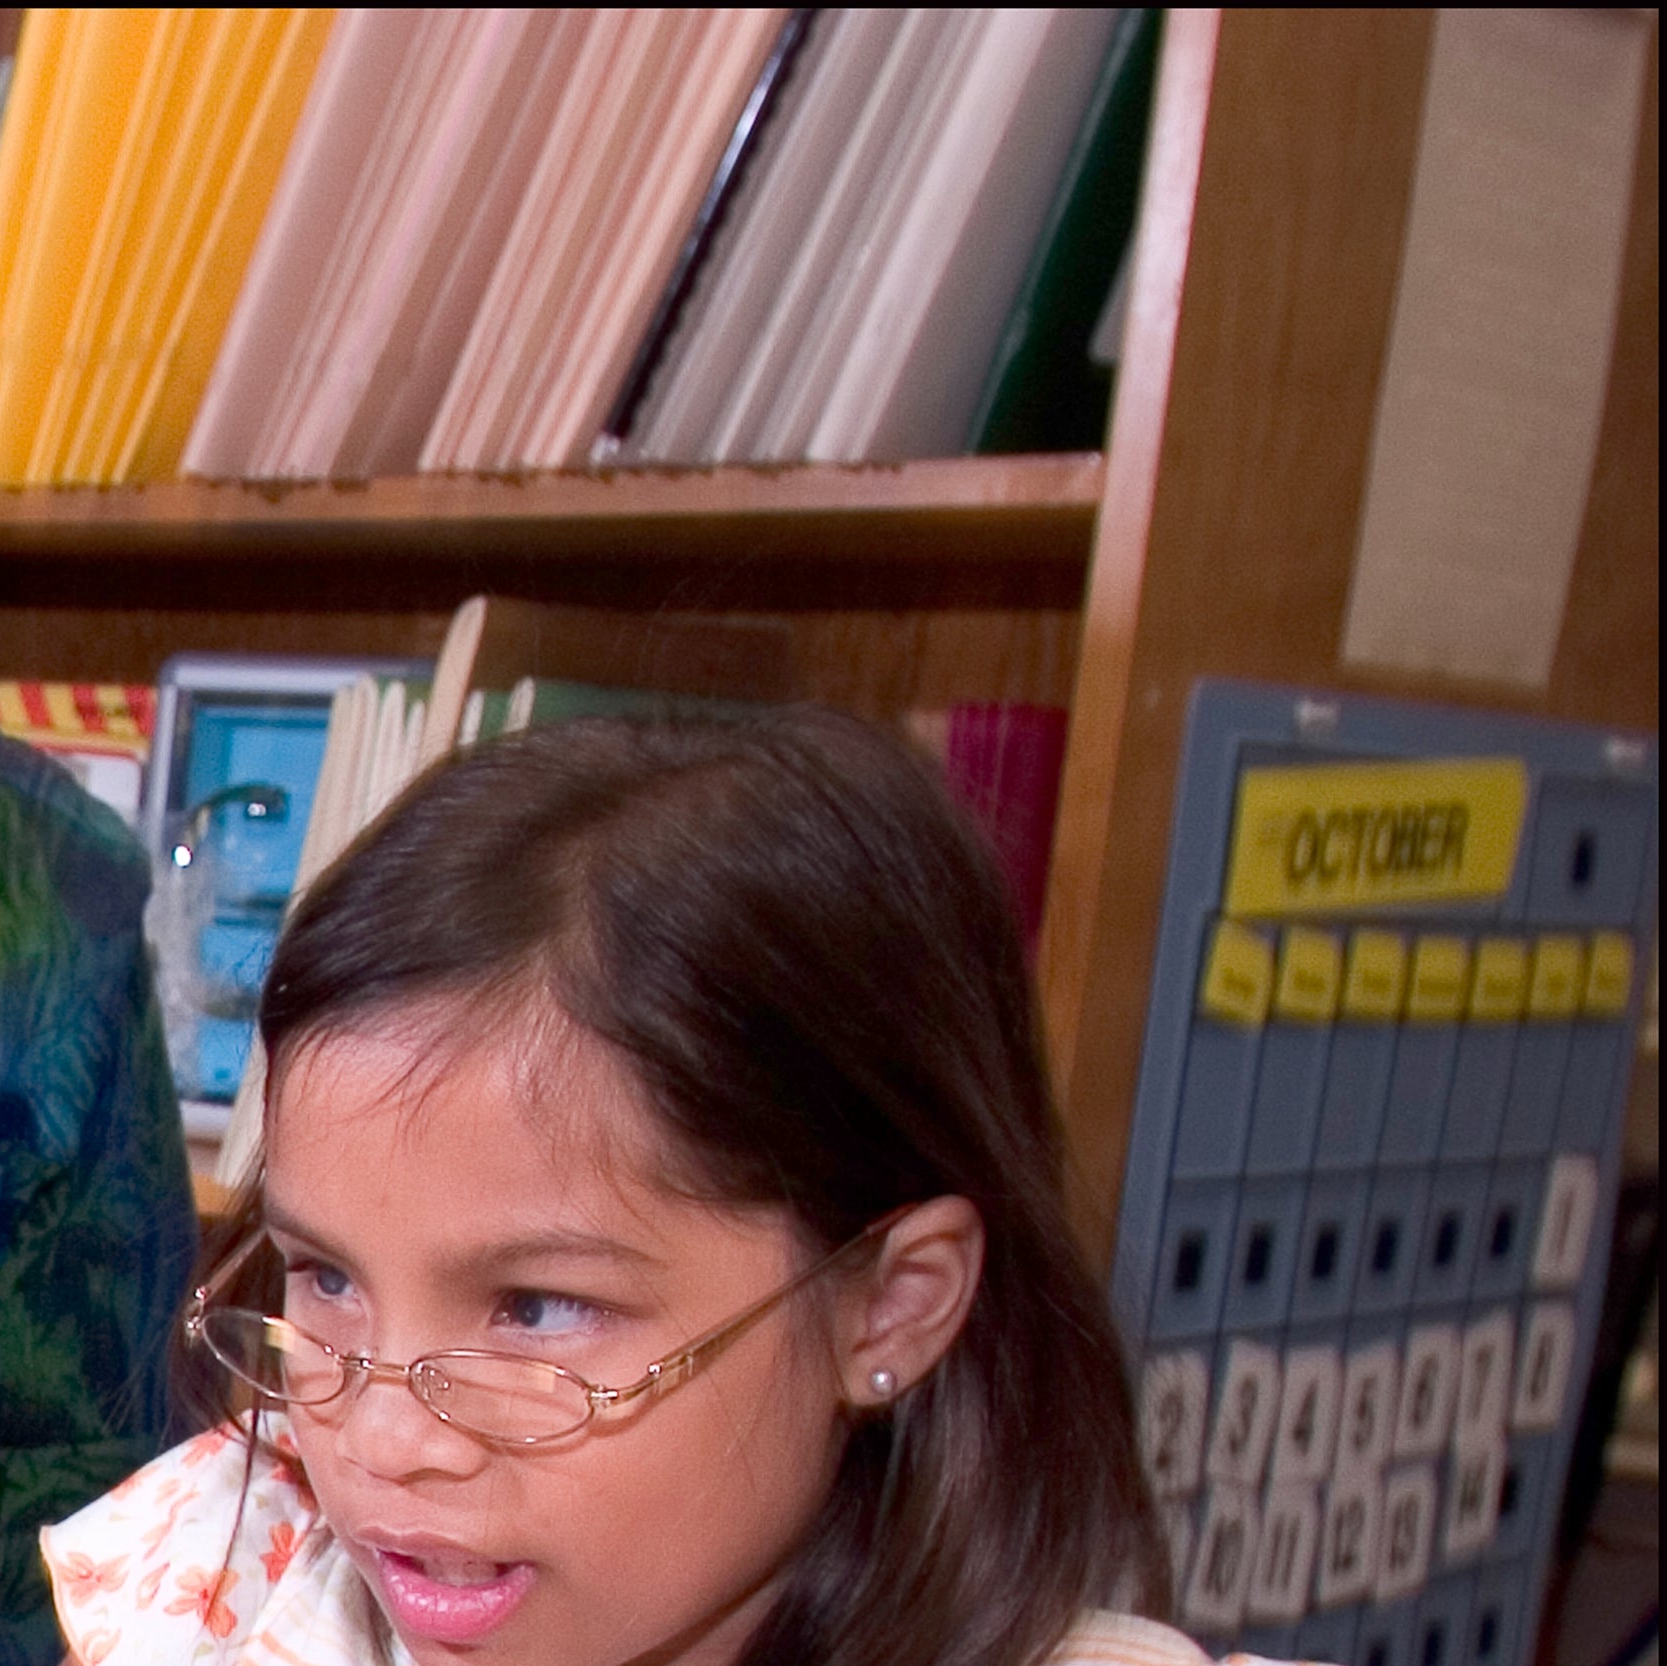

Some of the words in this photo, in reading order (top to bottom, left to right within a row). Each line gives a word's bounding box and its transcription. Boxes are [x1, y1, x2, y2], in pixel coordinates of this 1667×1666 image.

[1284, 802, 1469, 884] OCTOBER
[1229, 1376, 1259, 1446] 3
[1292, 1386, 1316, 1455] 4
